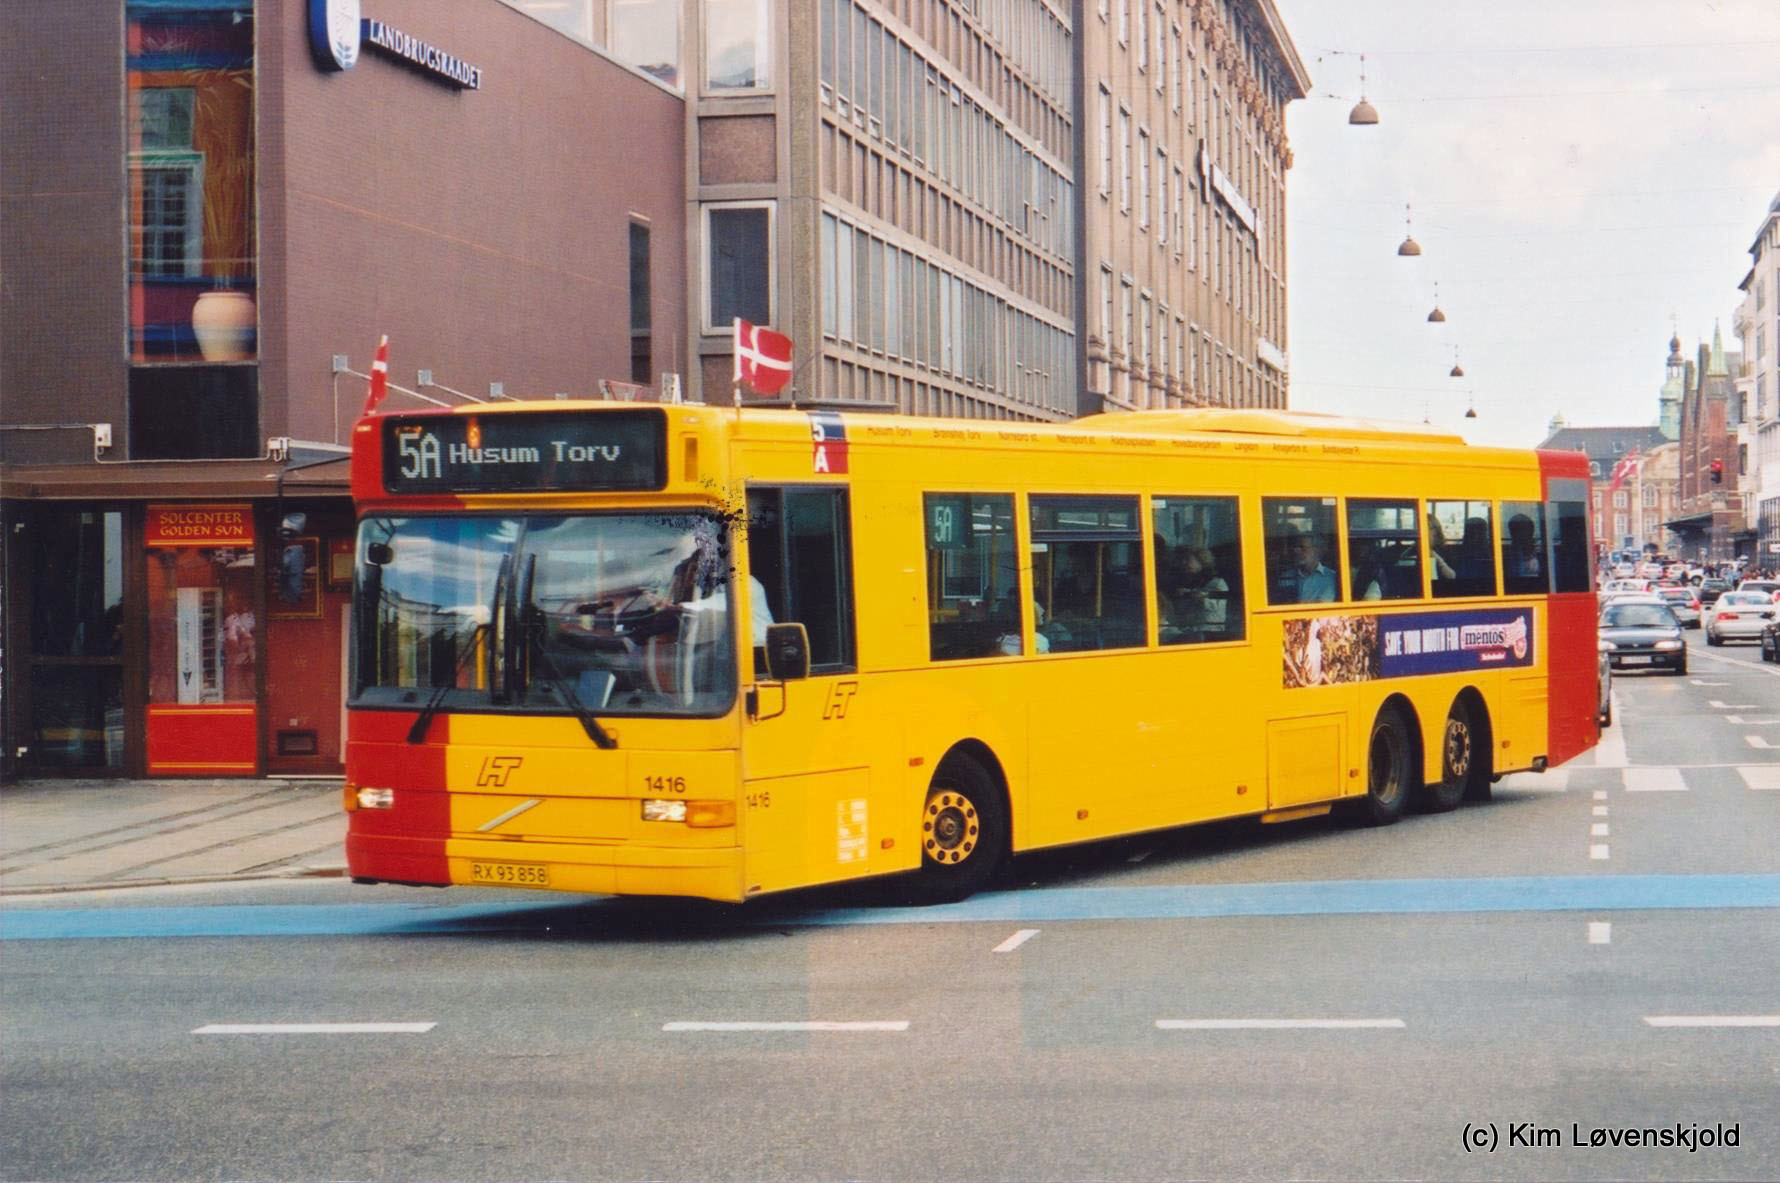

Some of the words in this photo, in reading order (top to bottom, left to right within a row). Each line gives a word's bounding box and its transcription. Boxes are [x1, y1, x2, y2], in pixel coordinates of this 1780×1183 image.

[369, 18, 482, 90] LANDBRUGSRAADET
[811, 415, 826, 442] 5
[399, 432, 441, 479] 5A
[449, 442, 540, 465] Husum
[551, 440, 620, 462] Torv
[814, 444, 830, 473] A
[160, 511, 242, 525] SOLCENTER
[160, 525, 211, 536] GOLDEN
[215, 525, 243, 536] SUN
[1465, 631, 1505, 646] mentos
[645, 776, 686, 793] 1416
[746, 791, 770, 808] 1416
[473, 864, 493, 880] RX
